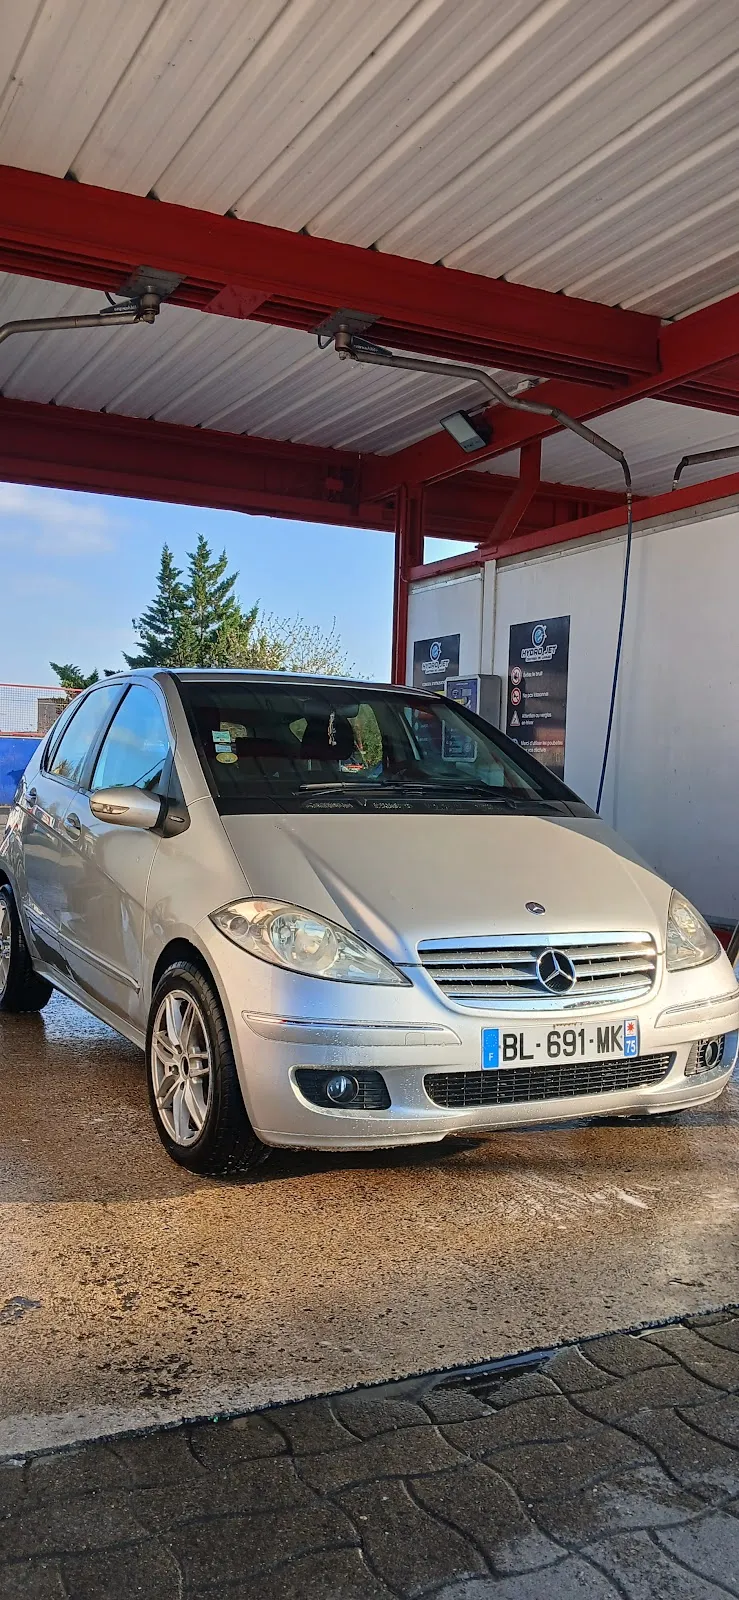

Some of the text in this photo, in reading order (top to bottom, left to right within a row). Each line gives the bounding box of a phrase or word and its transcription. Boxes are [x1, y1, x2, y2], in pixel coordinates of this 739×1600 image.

[521, 647, 543, 658] HYDRO
[544, 645, 557, 654] JET
[488, 1025, 636, 1062] F BL-691-MK 75
